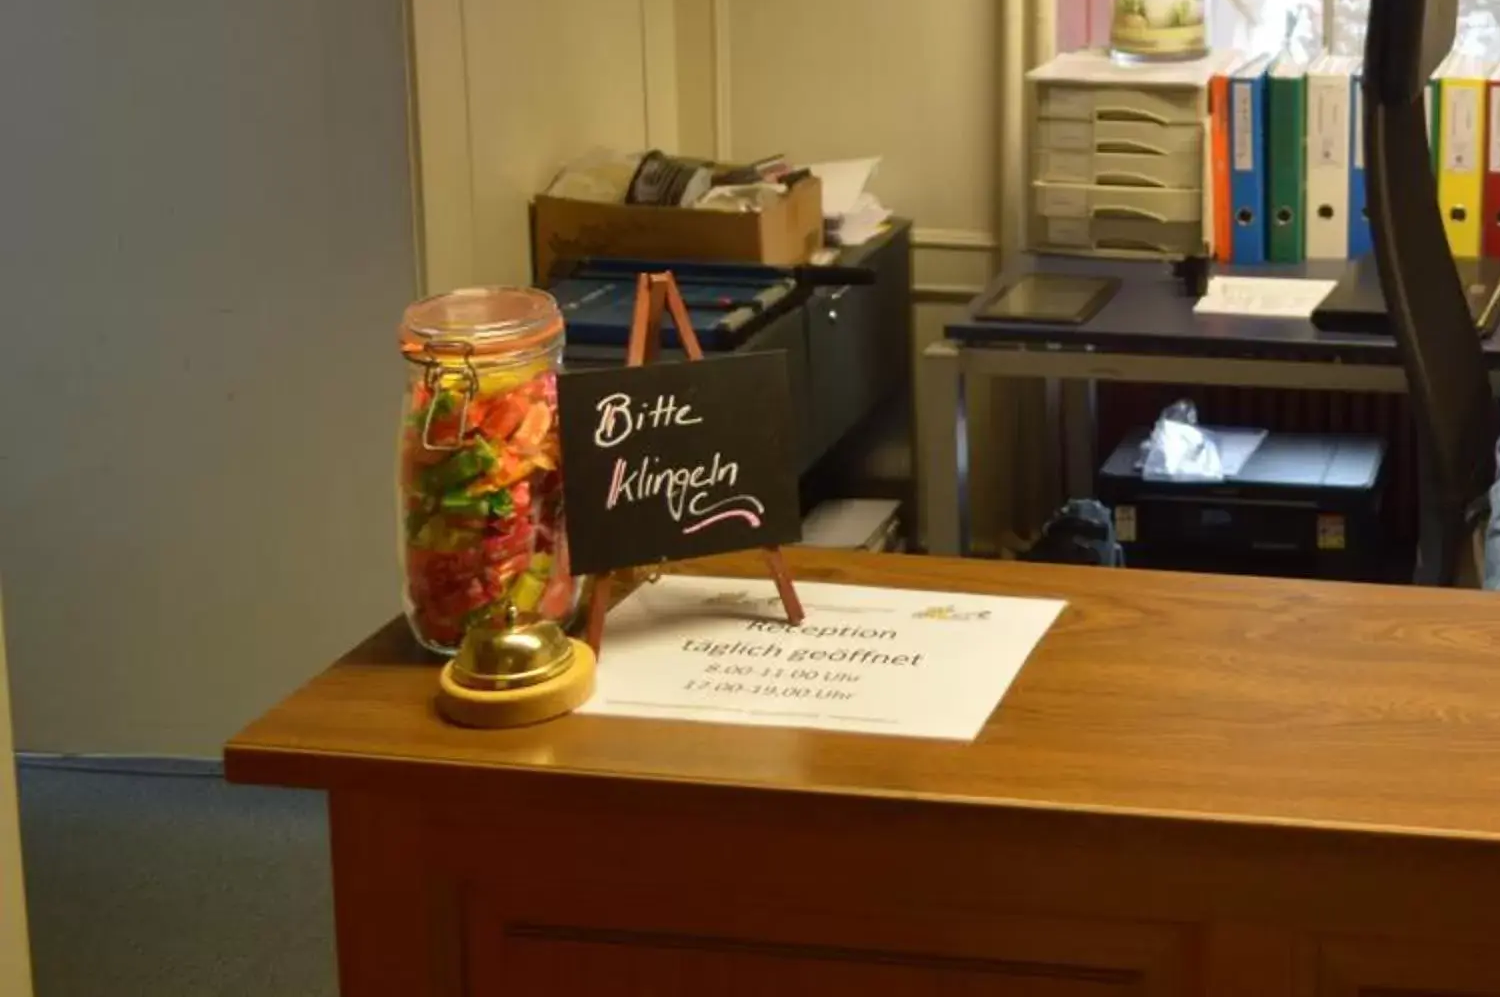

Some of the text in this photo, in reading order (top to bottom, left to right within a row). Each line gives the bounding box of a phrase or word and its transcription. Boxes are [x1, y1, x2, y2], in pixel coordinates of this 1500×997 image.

[595, 393, 703, 448] Bitte
[746, 618, 898, 641] Reception
[681, 639, 926, 667] täglich geöffnet
